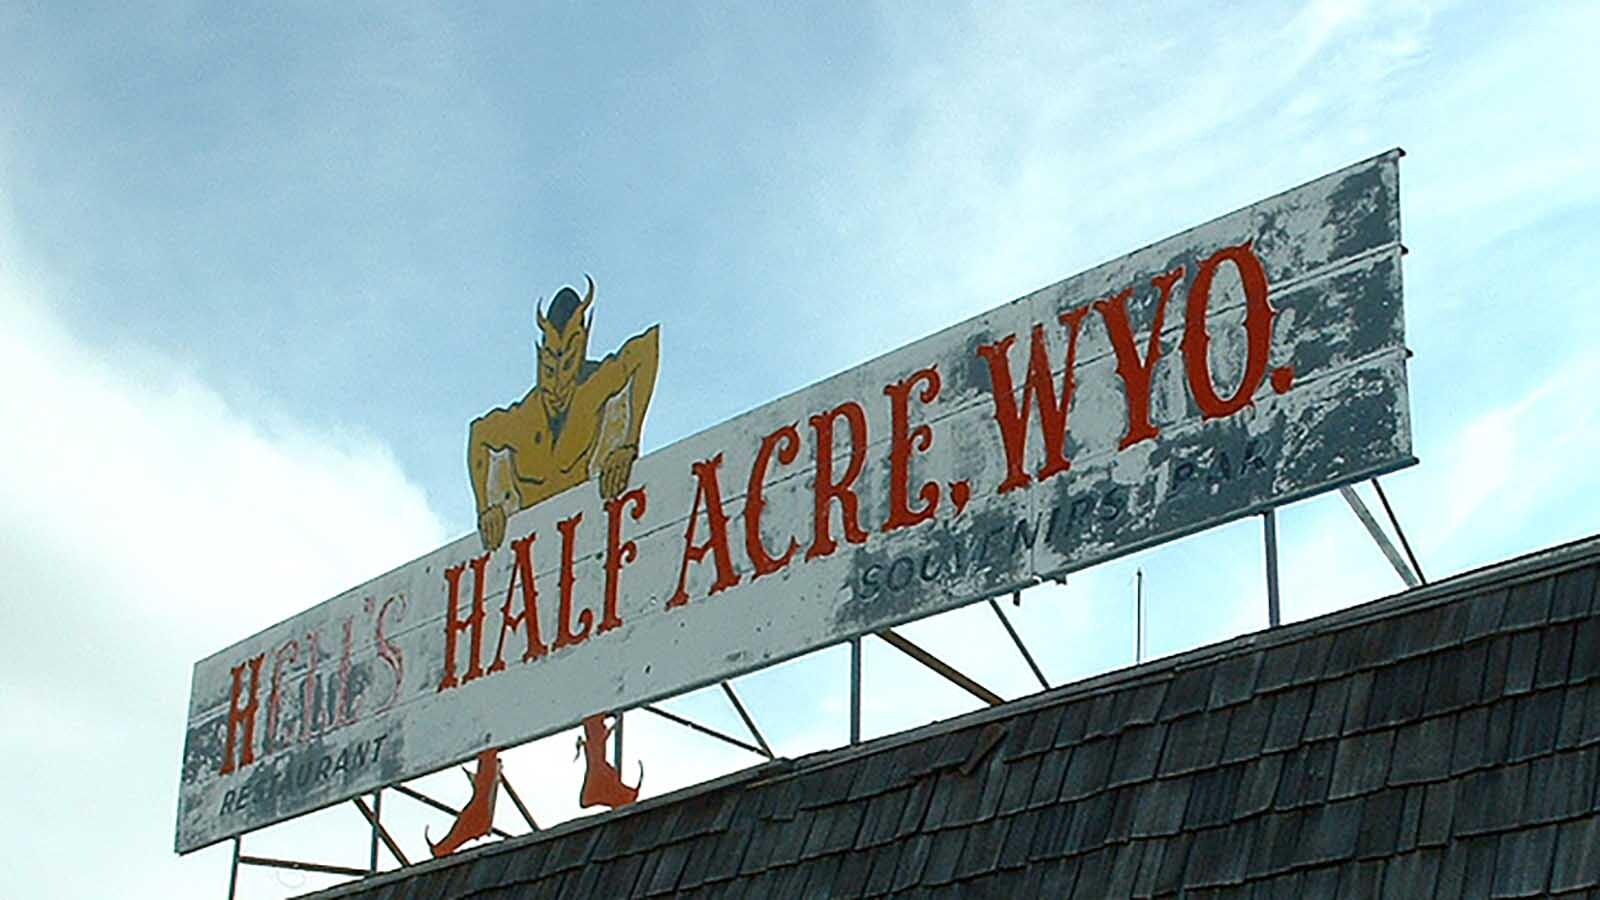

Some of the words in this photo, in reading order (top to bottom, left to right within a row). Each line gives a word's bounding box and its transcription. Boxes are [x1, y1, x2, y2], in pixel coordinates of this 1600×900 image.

[220, 593, 408, 776] HELL'S
[437, 484, 647, 693] HALF
[665, 364, 971, 612] ACRE,
[977, 237, 1295, 493] WYO.
